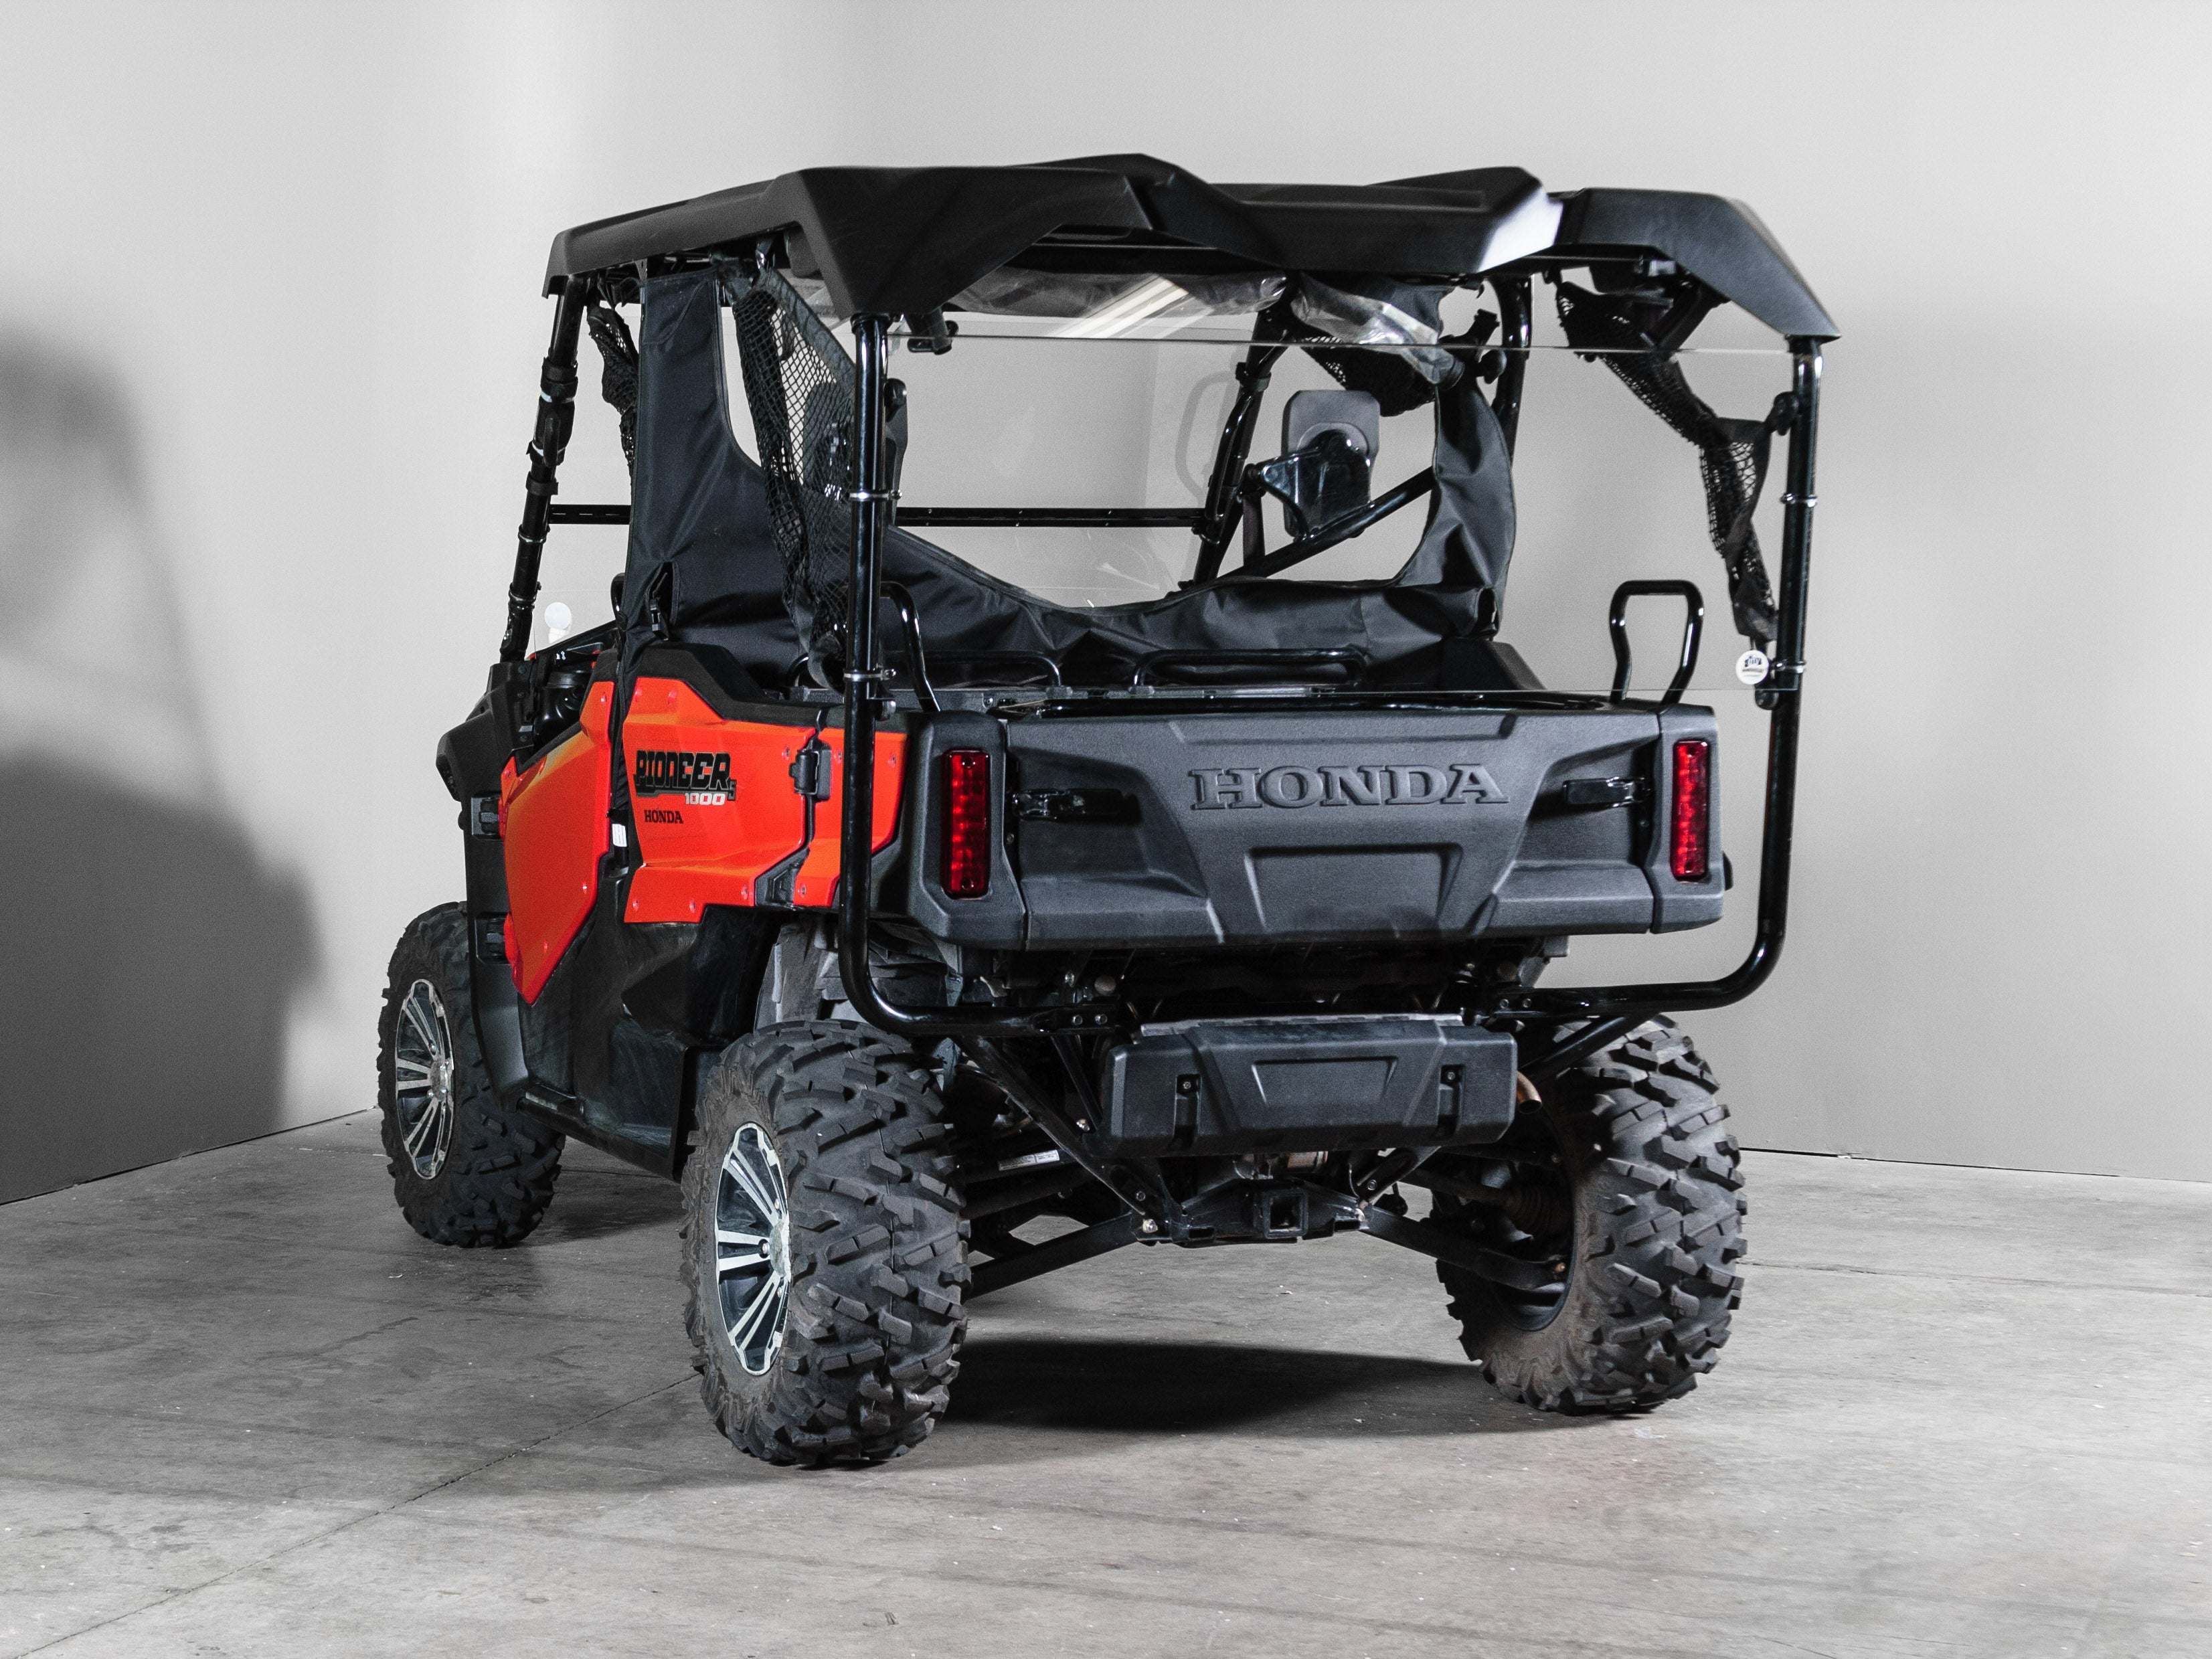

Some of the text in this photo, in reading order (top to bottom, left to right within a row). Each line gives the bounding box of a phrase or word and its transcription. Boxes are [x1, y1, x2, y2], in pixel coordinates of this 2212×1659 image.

[635, 750, 731, 790] PIONEER
[685, 792, 726, 806] 1000
[1188, 763, 1510, 810] HONDA
[643, 809, 684, 824] HONDA
